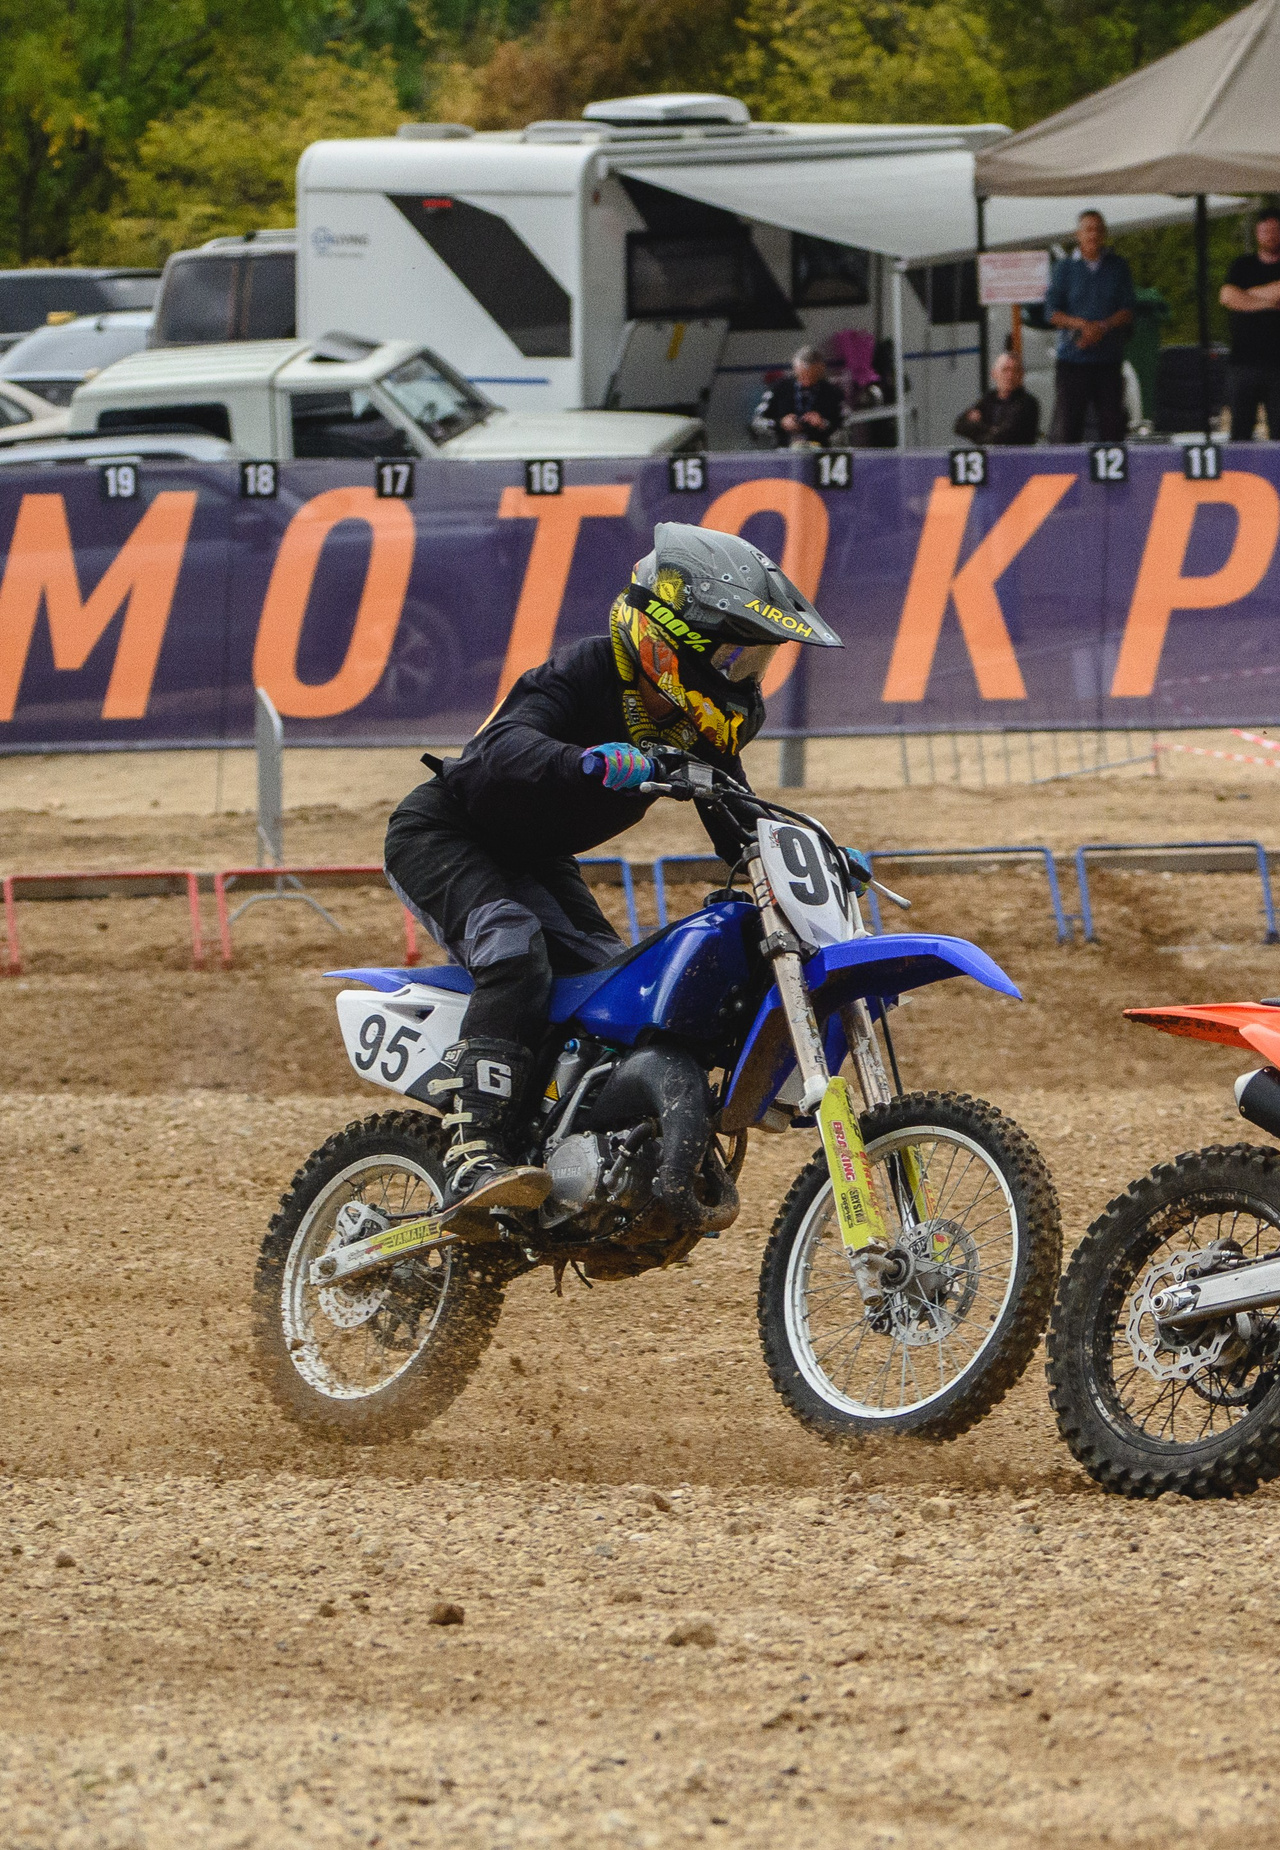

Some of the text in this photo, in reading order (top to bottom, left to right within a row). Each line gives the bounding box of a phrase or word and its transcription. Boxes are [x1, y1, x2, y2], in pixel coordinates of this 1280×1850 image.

[531, 462, 558, 492] 16
[675, 459, 702, 488] 15
[820, 456, 847, 484] 14
[956, 452, 983, 482] 13
[1096, 448, 1123, 478] 12
[1190, 448, 1217, 477] 11
[106, 466, 135, 497] 19
[246, 464, 273, 494] 18
[383, 465, 410, 493] 17
[645, 599, 712, 652] 100%
[744, 599, 813, 638] AIROH
[780, 826, 849, 922] 95
[354, 1013, 421, 1082] 95
[476, 1059, 512, 1098] G
[391, 1225, 431, 1247] YAMAHA
